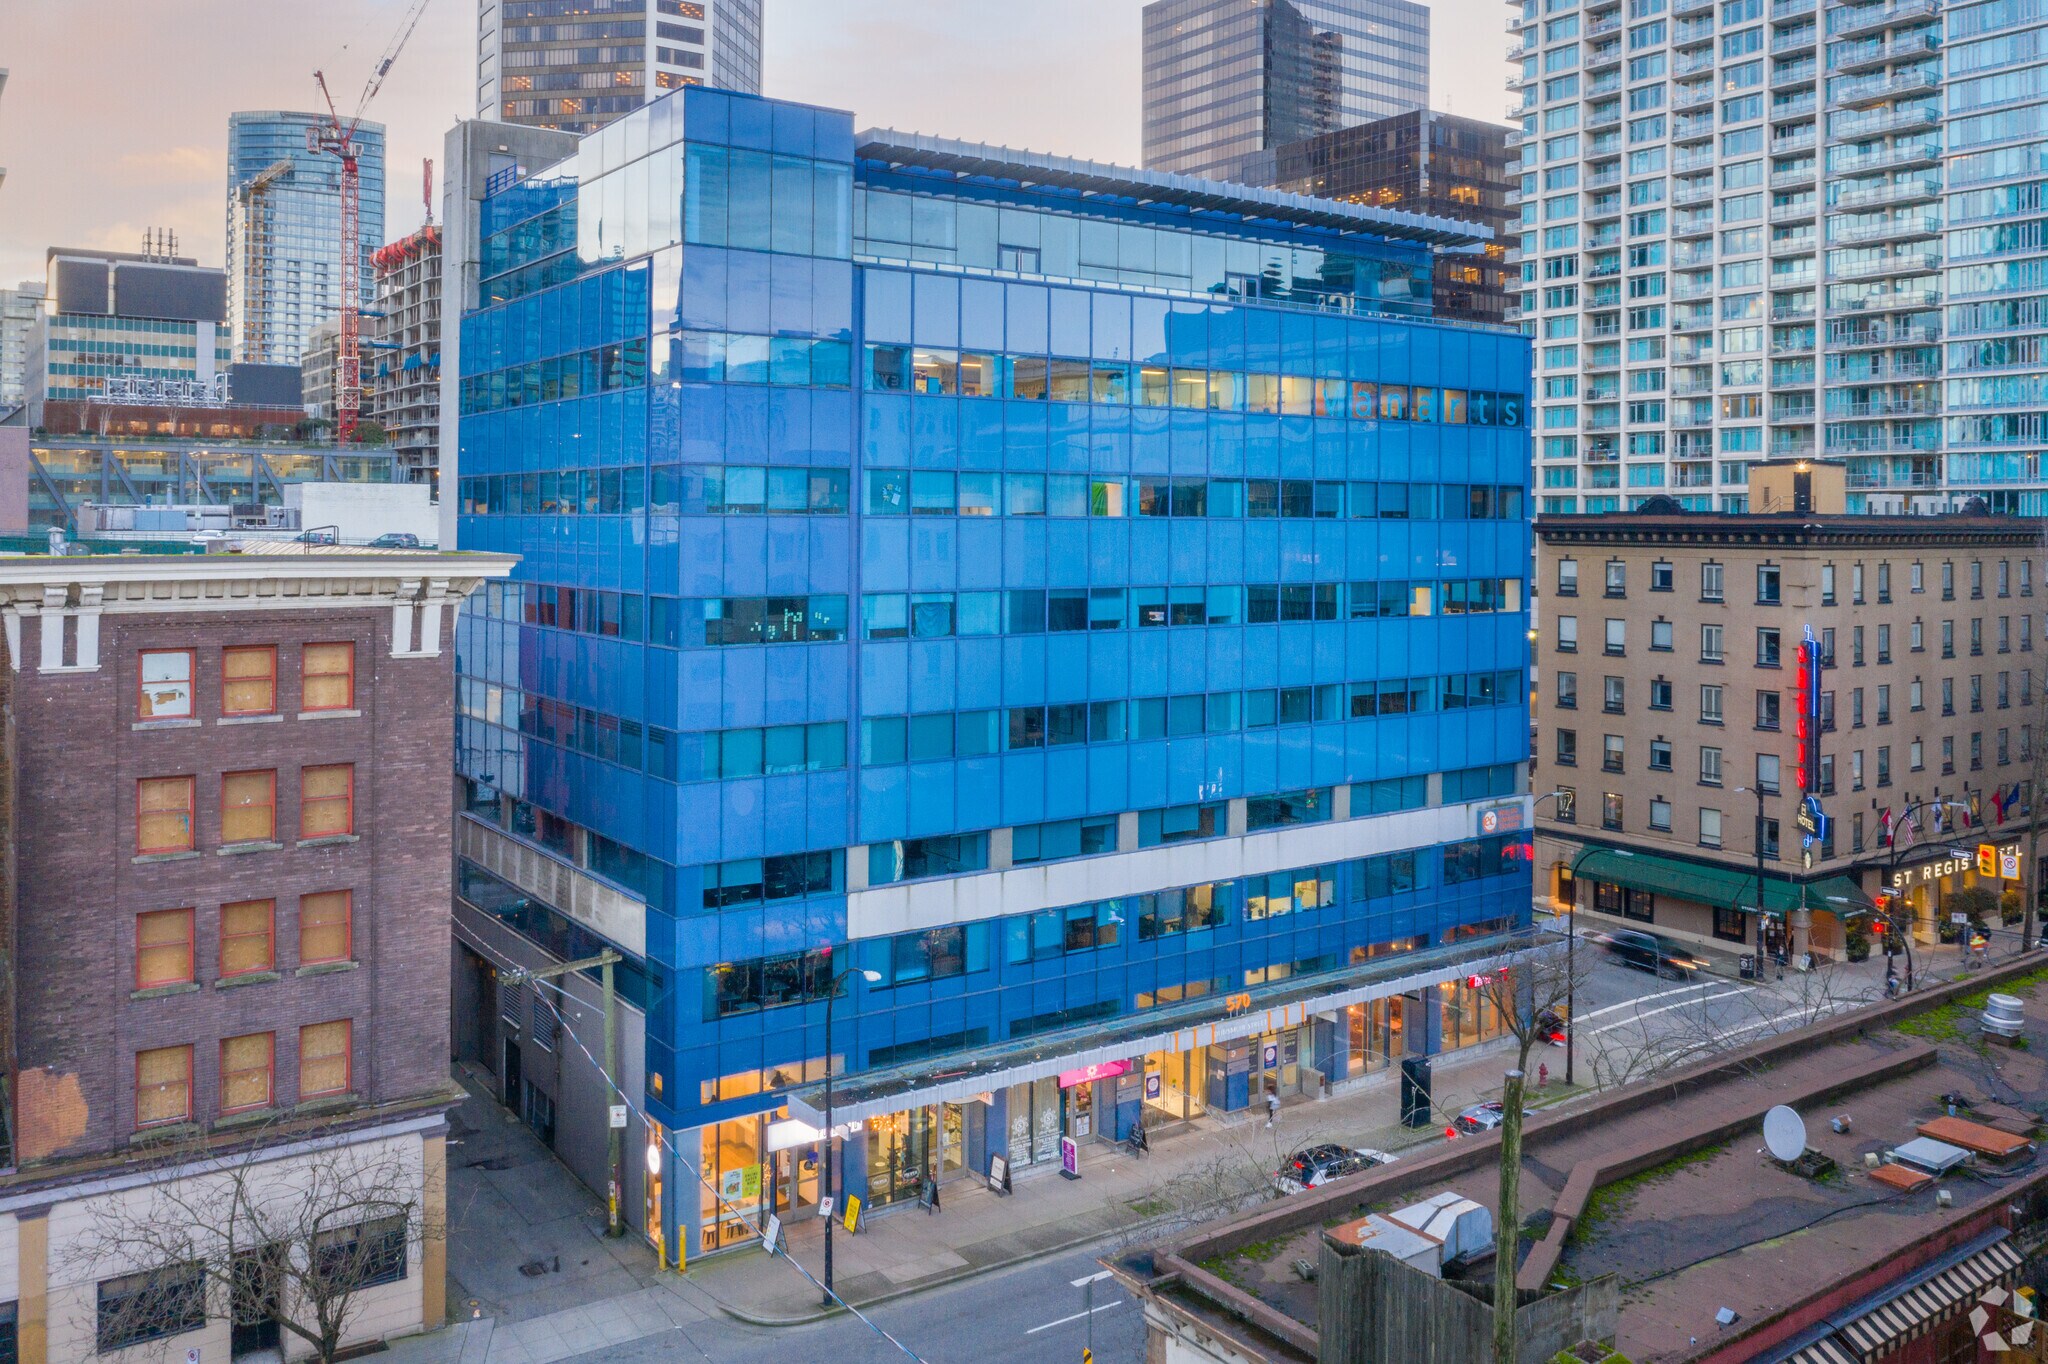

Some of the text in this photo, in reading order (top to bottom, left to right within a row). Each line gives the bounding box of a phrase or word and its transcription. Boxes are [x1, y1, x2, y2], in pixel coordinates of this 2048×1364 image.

[1798, 814, 1815, 832] HOTEL
[1893, 870, 1912, 887] ST
[1923, 858, 1969, 880] REGIS
[1226, 993, 1251, 1012] 570
